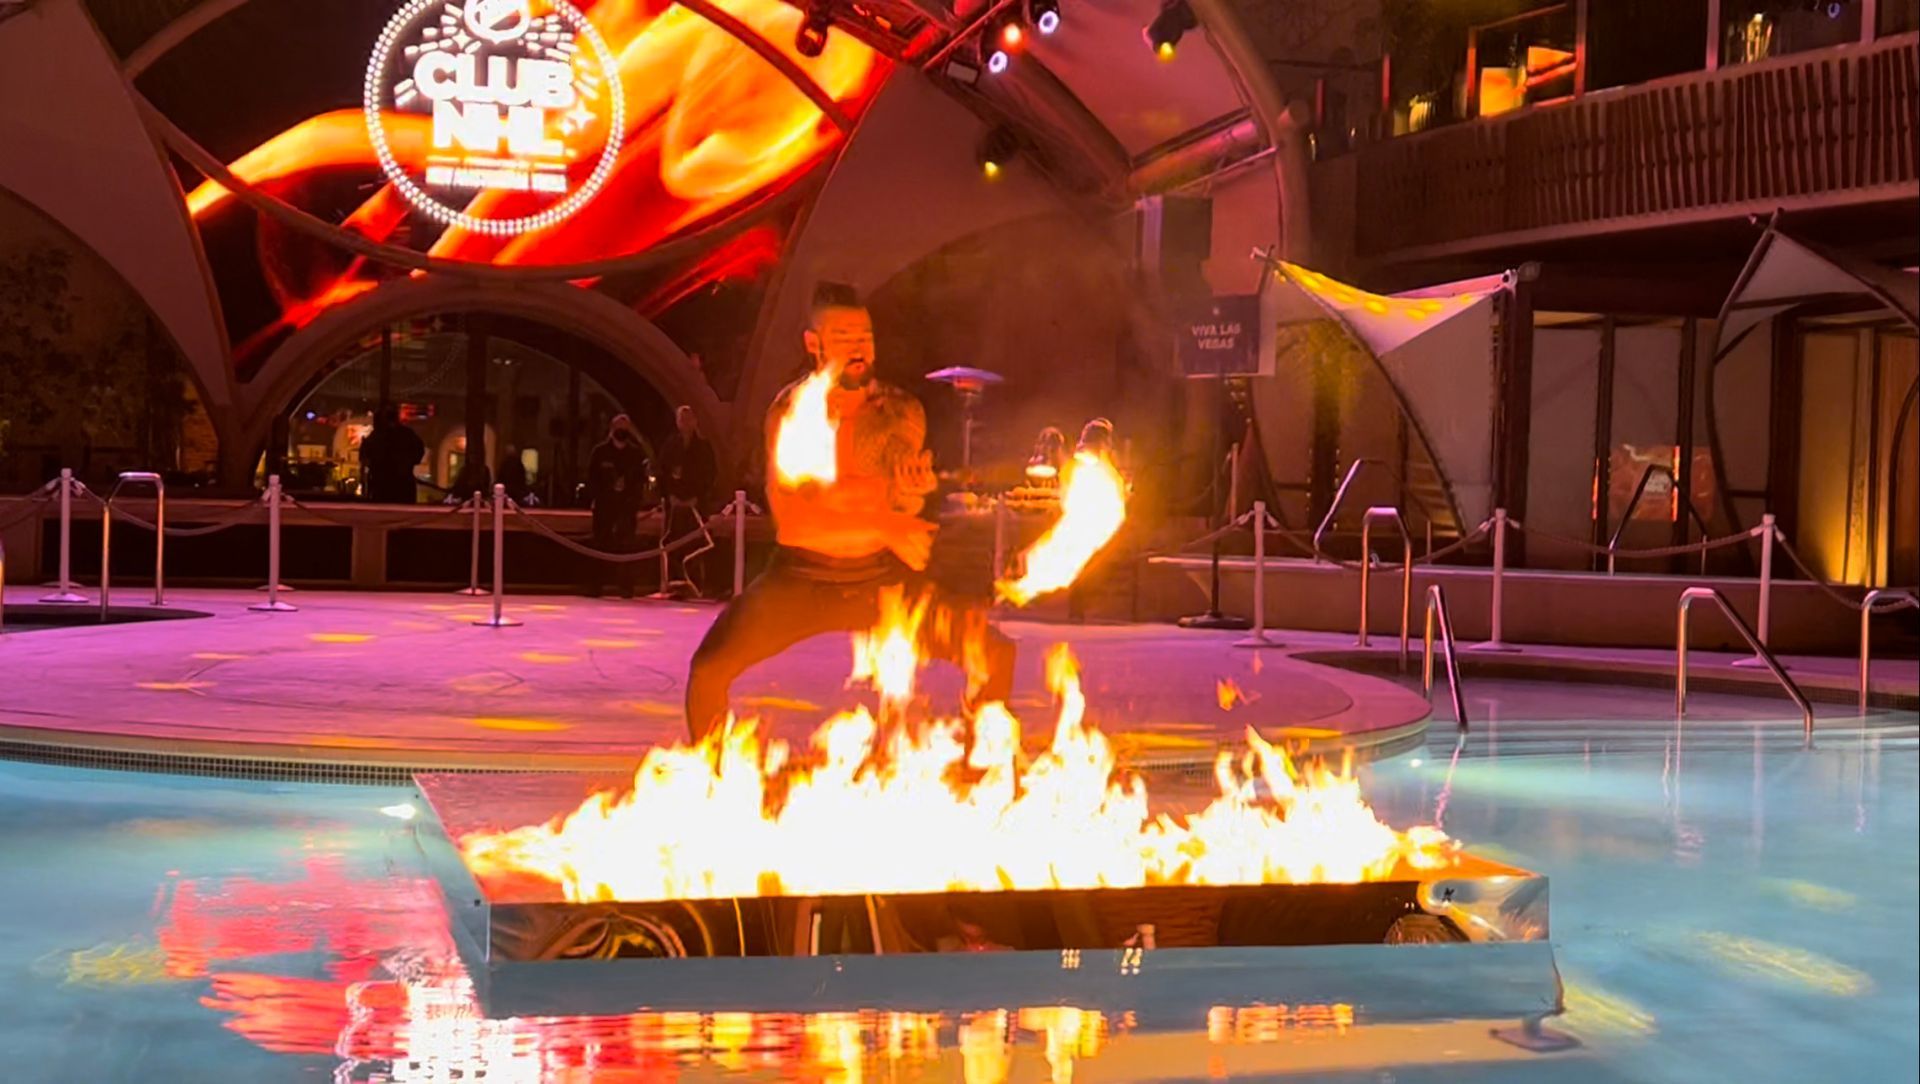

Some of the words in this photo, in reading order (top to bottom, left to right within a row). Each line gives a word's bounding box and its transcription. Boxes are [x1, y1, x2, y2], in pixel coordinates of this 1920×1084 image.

[414, 52, 576, 108] CLUB
[432, 103, 563, 156] NHL
[1192, 325, 1217, 336] VIVA
[1220, 323, 1242, 335] LAS
[1198, 337, 1234, 349] VEGAS
